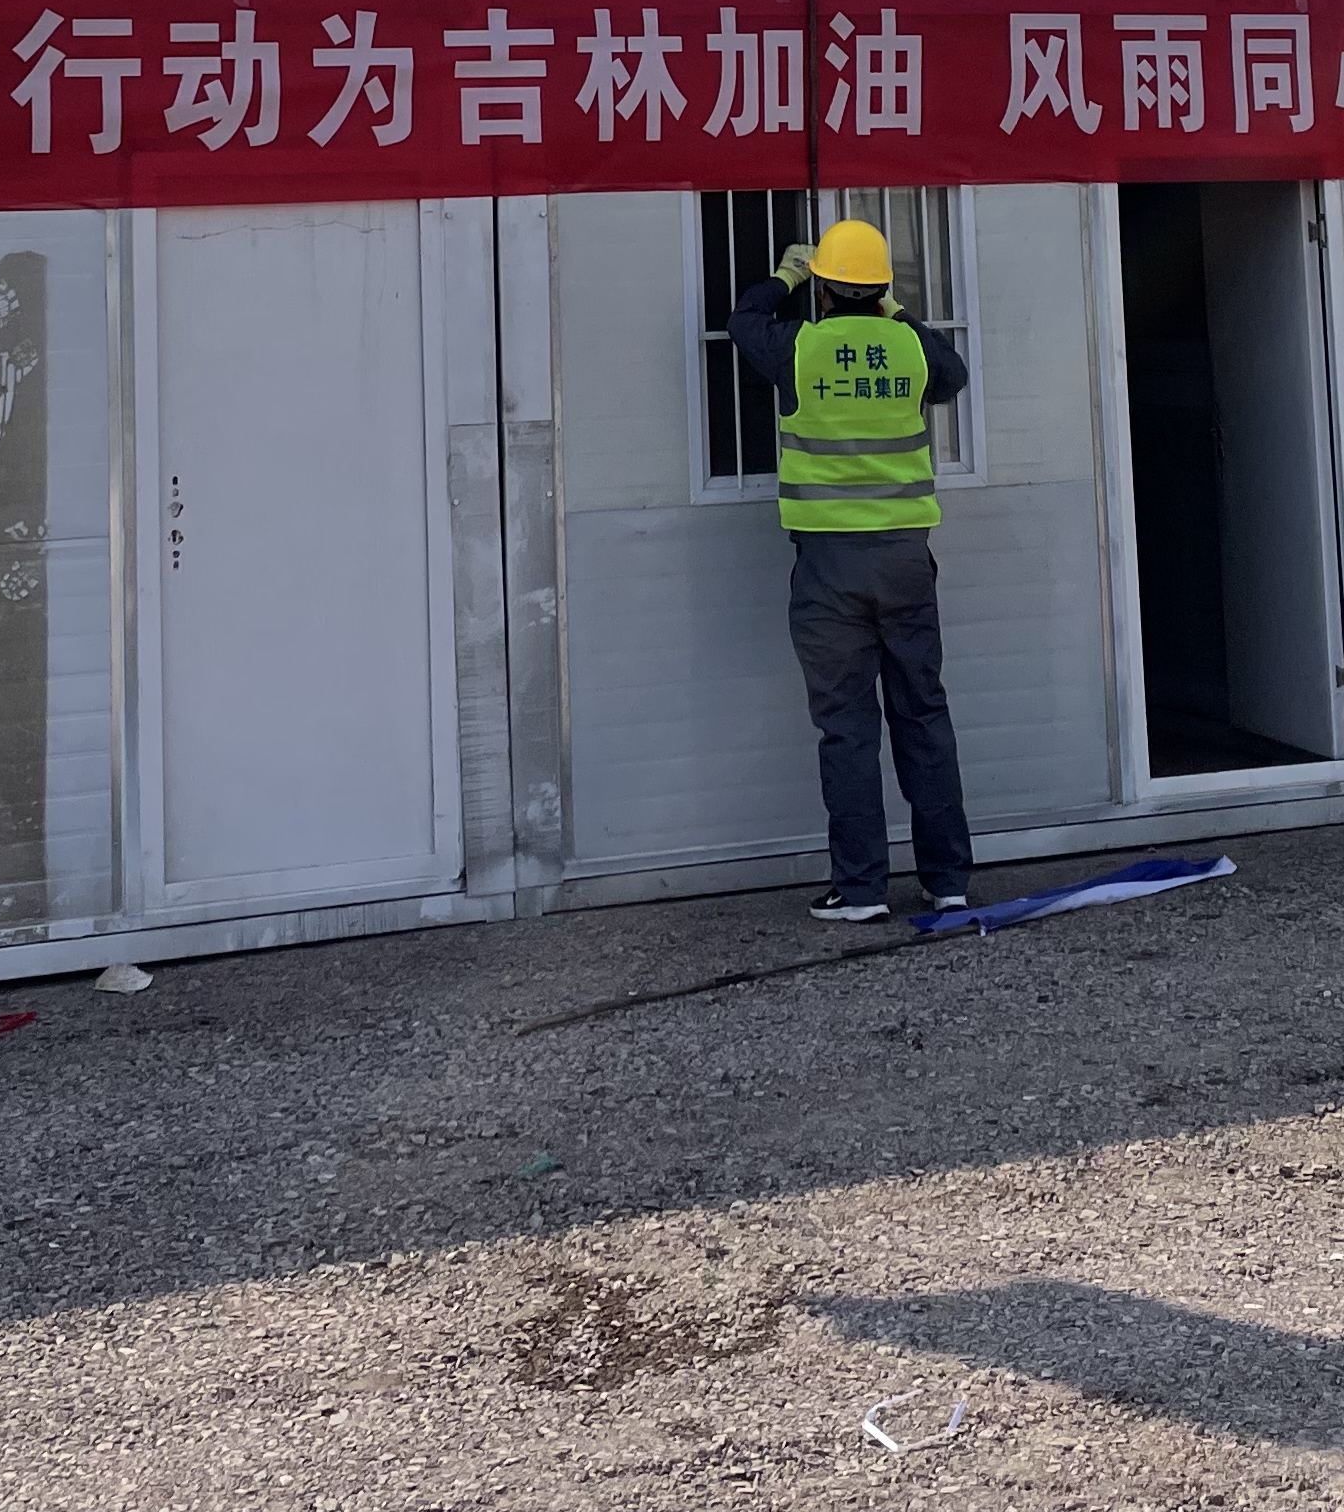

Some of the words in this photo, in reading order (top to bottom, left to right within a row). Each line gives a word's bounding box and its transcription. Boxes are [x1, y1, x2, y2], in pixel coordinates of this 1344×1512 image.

[835, 344, 889, 372] 中铁
[812, 375, 911, 400] 十二局集团
